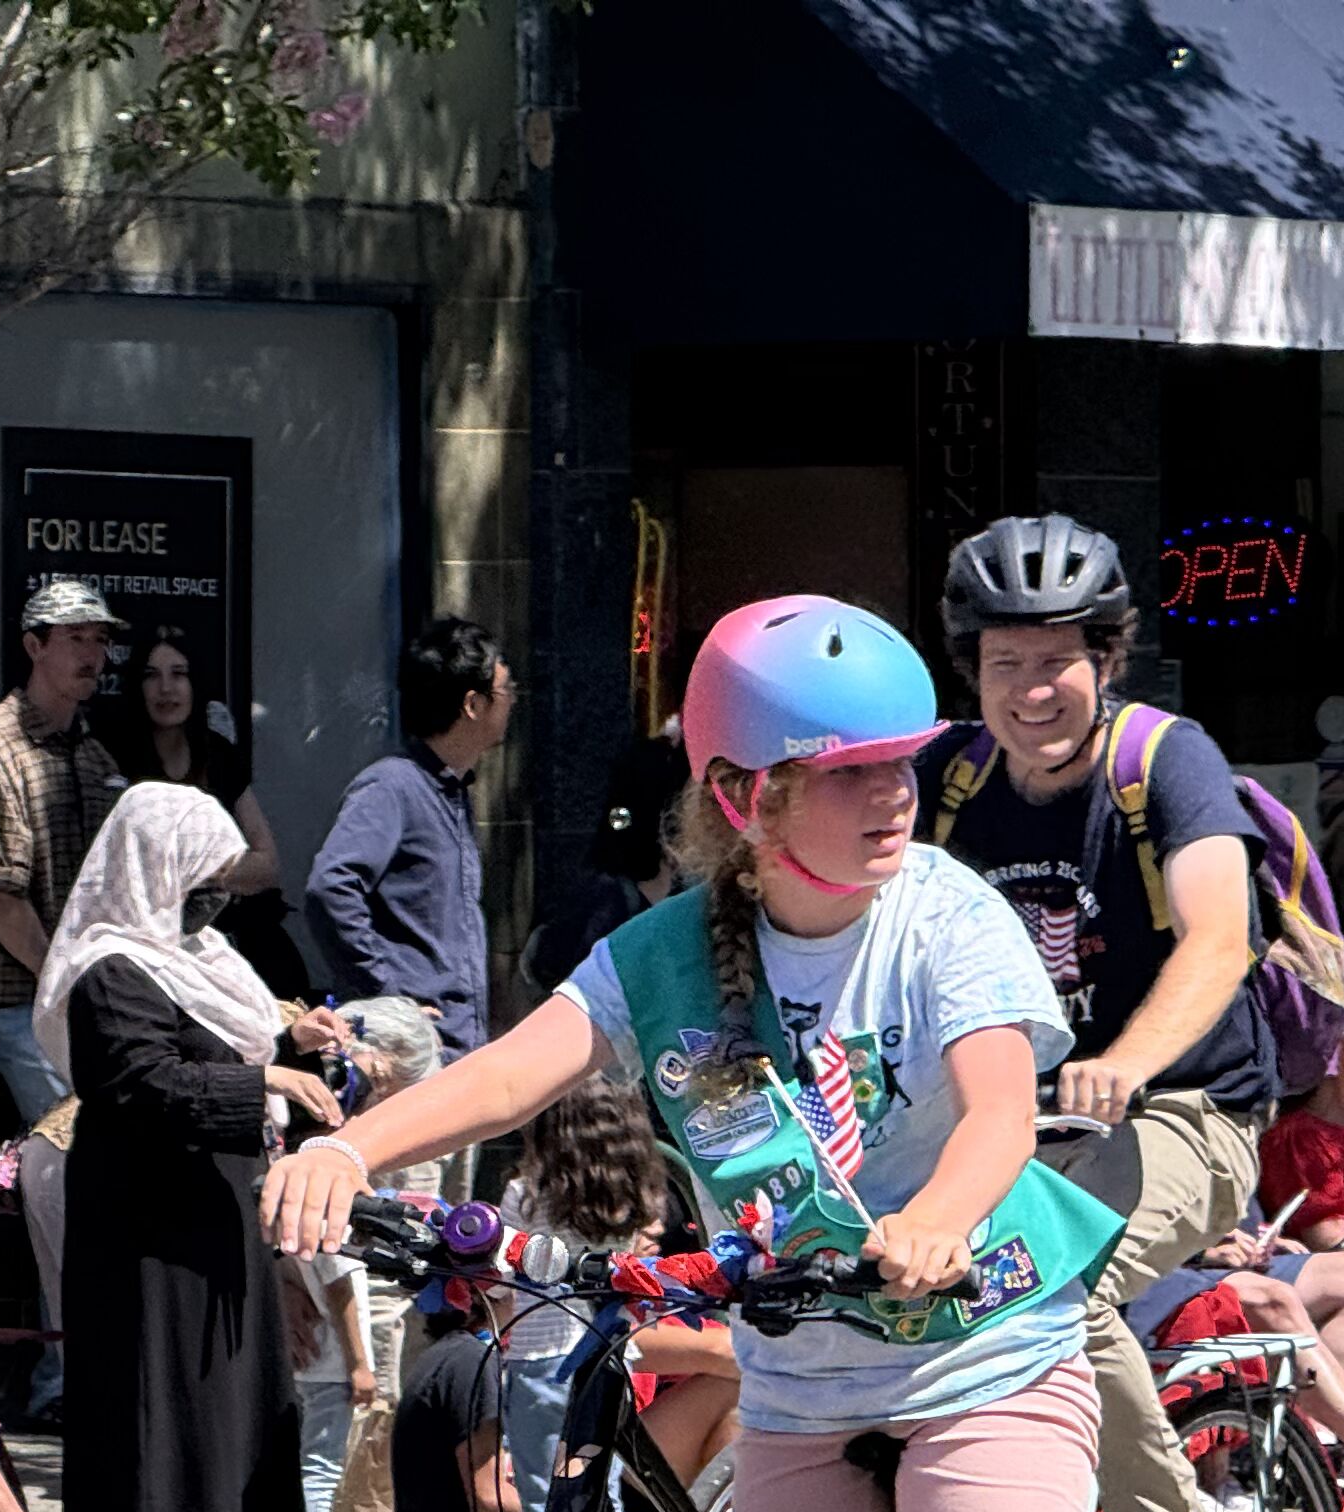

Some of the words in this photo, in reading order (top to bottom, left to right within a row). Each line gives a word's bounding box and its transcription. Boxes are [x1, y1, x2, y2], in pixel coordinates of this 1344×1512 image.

[27, 517, 83, 552] FOR
[87, 519, 169, 556] LEASE
[103, 574, 121, 594] FT
[123, 575, 171, 596] RETAIL
[172, 577, 221, 598] SPACE
[1159, 533, 1307, 608] OPEN
